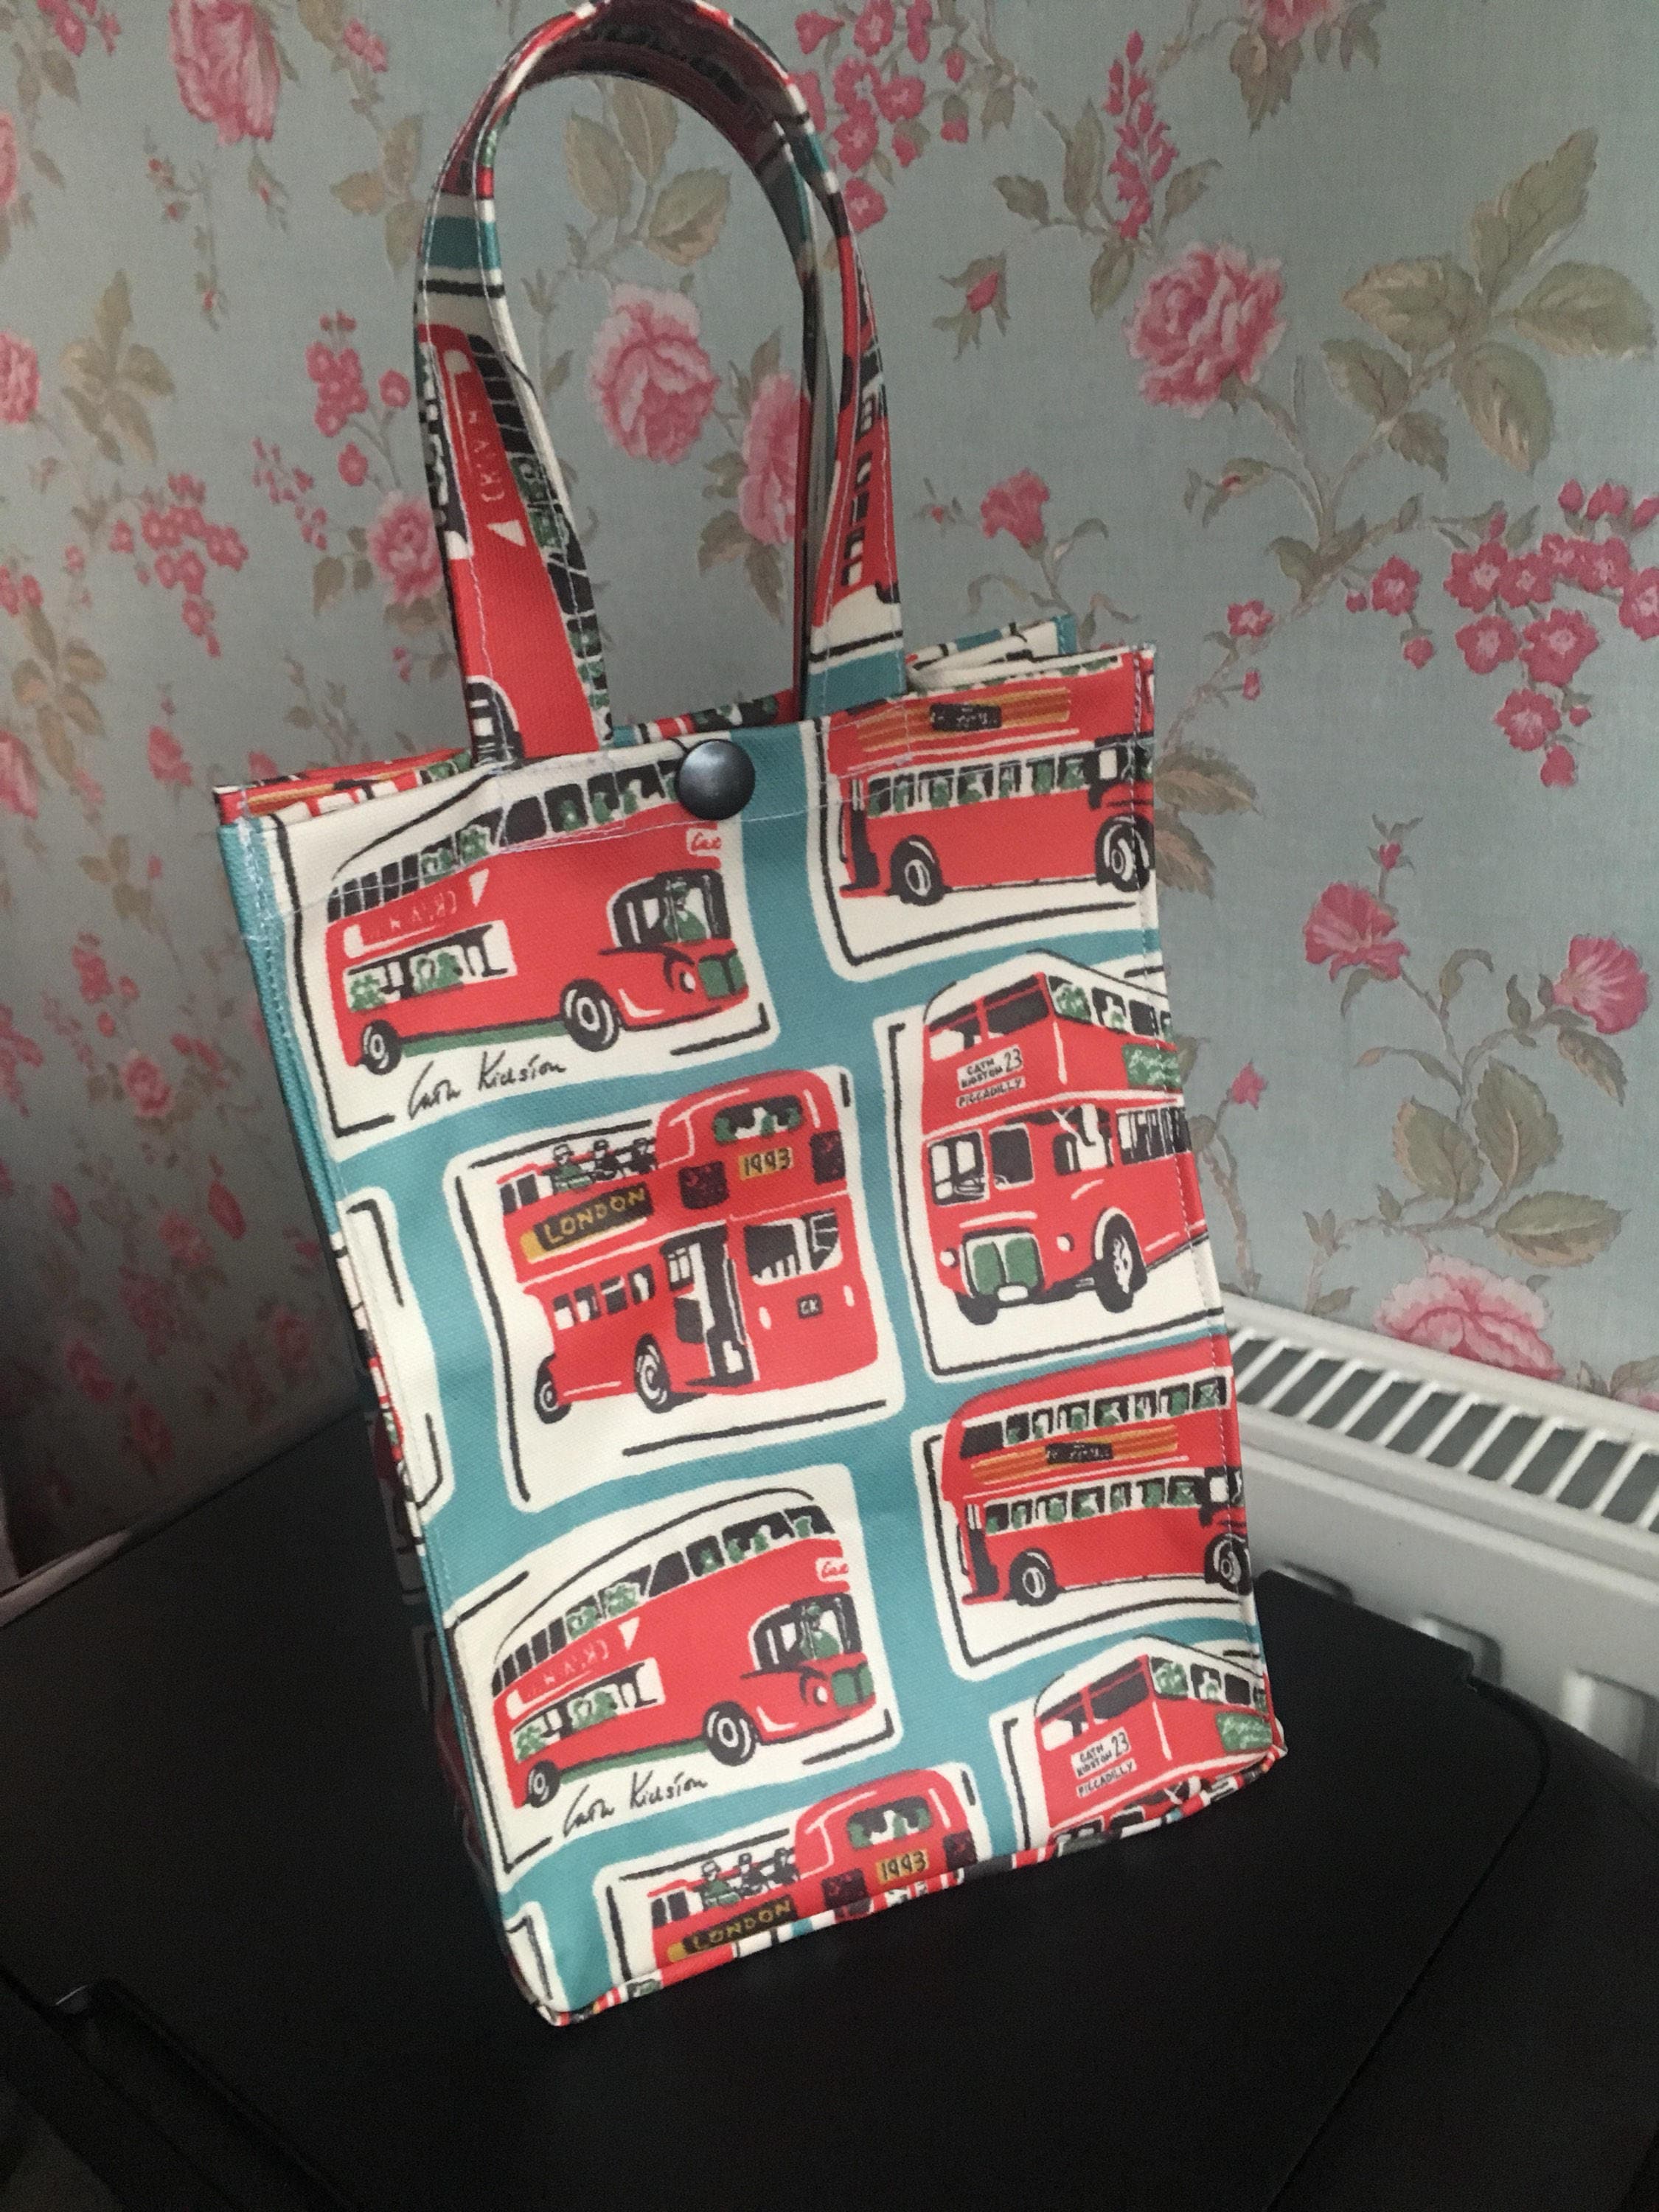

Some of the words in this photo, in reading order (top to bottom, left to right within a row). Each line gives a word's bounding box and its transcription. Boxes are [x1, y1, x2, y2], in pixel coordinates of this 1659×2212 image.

[1004, 1048, 1023, 1073] 23
[959, 1078, 1022, 1107] PICCADILLY
[743, 1147, 791, 1176] 1993
[543, 1188, 645, 1244] LONDON
[1111, 1731, 1130, 1757] 23
[1079, 1761, 1133, 1798] PICCADILLY
[880, 1850, 927, 1881] 1993
[692, 1899, 791, 1950] LONDON
